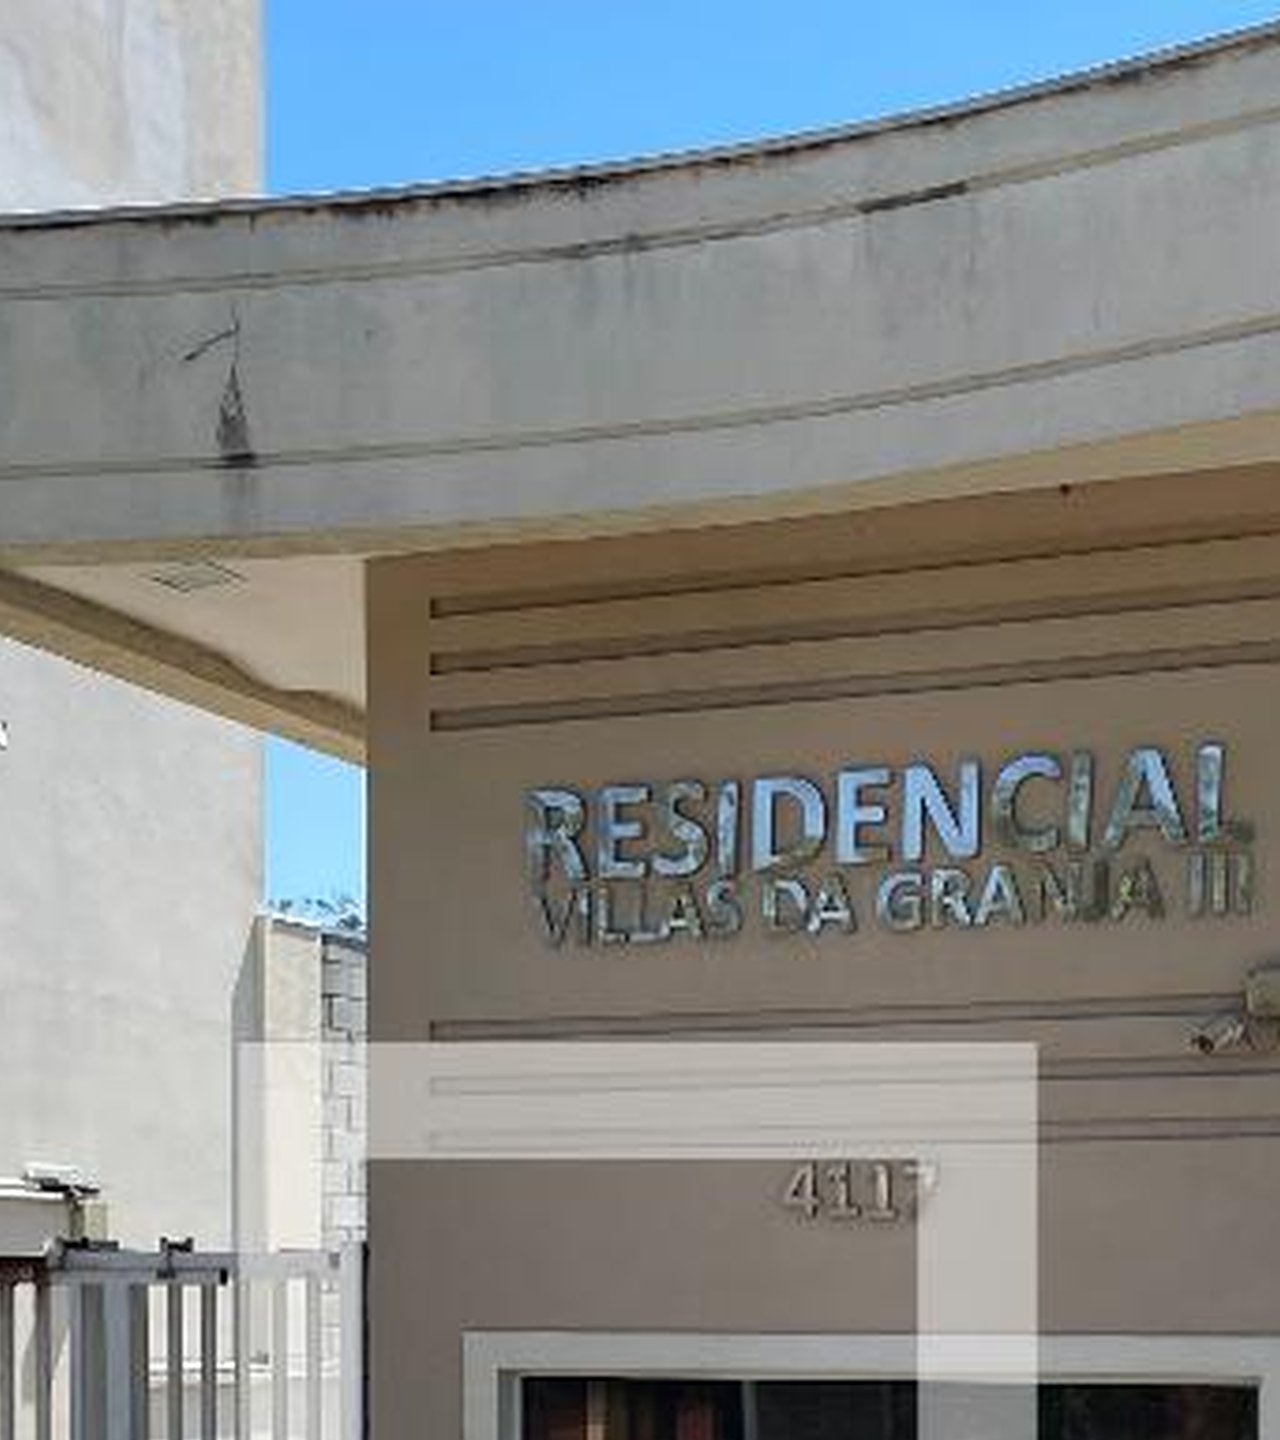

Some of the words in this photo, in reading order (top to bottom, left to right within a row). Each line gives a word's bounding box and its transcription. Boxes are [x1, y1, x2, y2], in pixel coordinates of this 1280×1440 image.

[526, 741, 1255, 883] RESIDENCIAL
[534, 878, 744, 950] VILLAS
[762, 870, 858, 937] DA
[875, 856, 1166, 933] GRANJA
[1185, 848, 1256, 919] III
[782, 1160, 940, 1222] 4117
